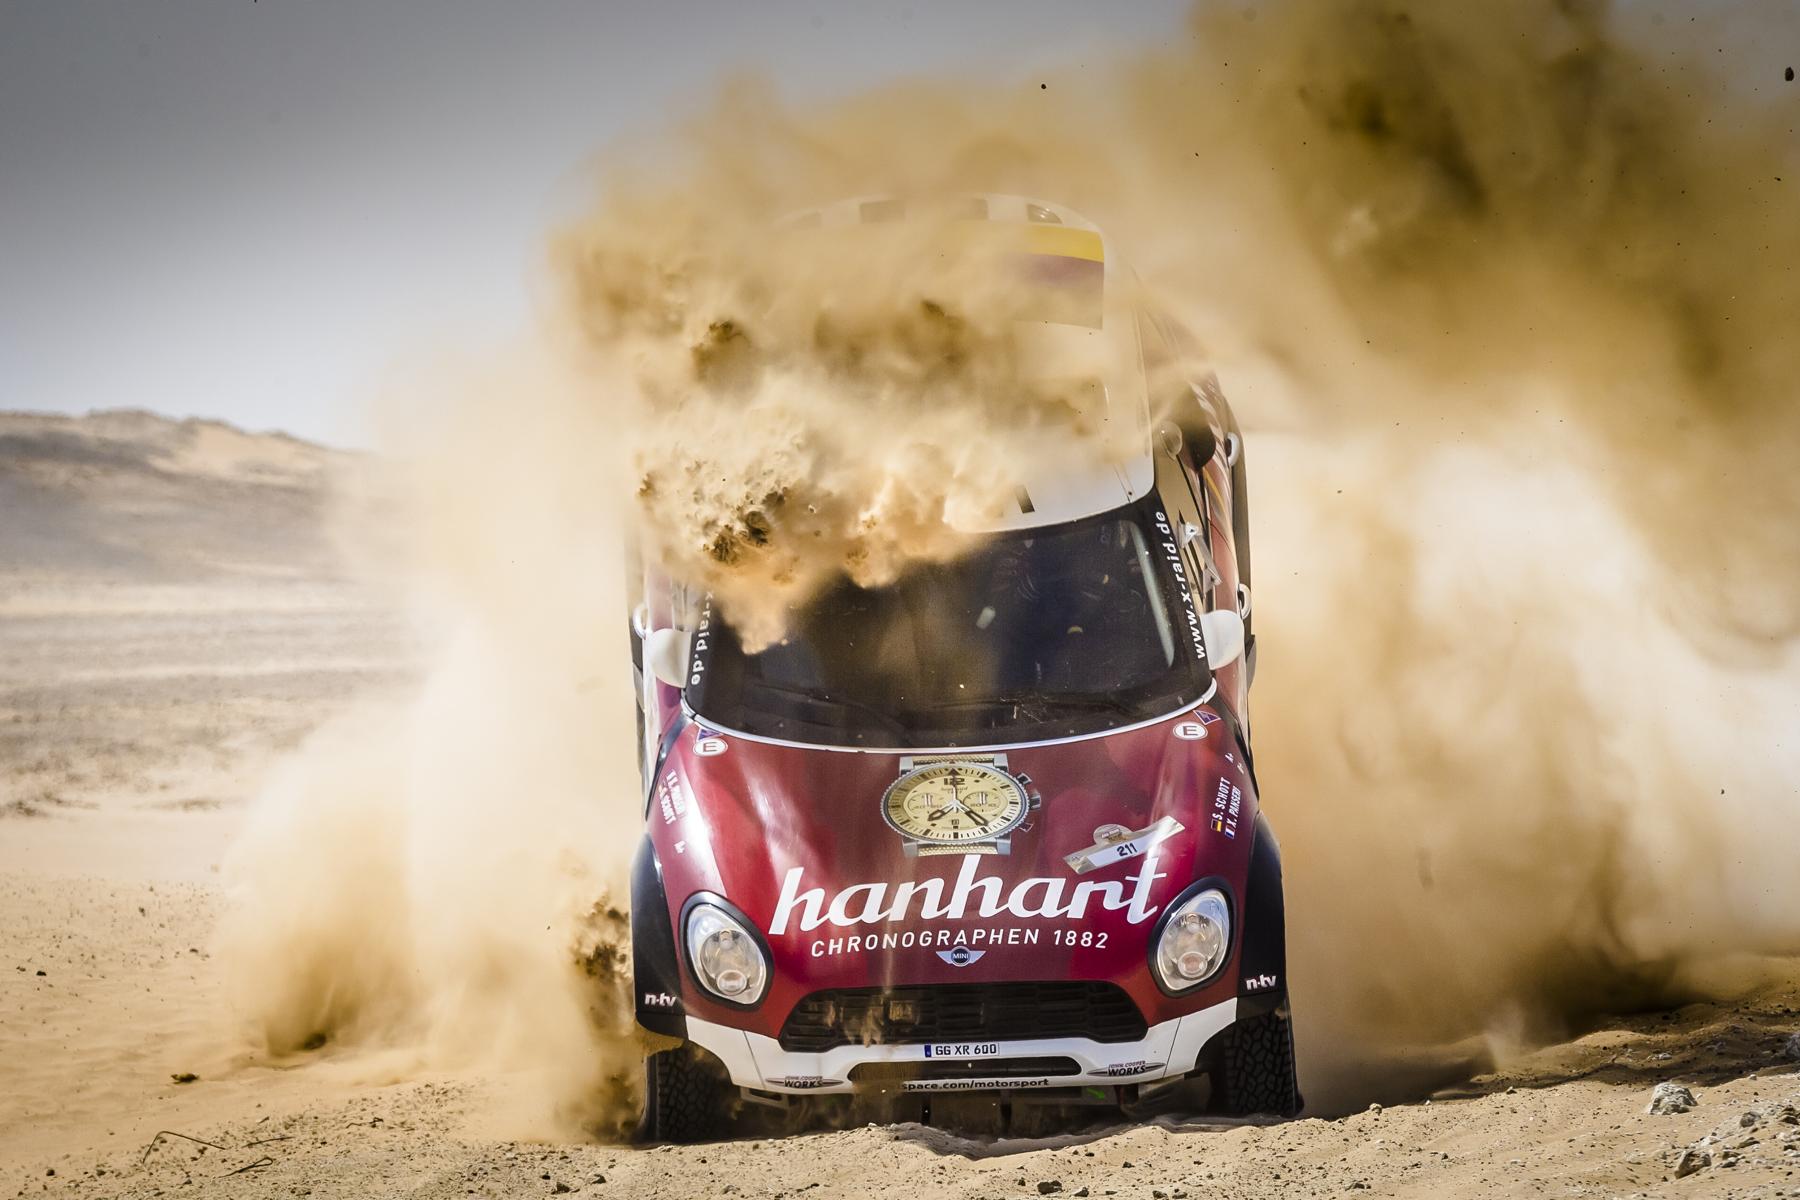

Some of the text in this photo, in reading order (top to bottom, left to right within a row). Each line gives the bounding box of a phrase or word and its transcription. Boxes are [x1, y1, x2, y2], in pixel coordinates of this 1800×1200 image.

[1156, 511, 1206, 659] www.x-raid.de
[1182, 725, 1198, 736] E
[703, 741, 718, 752] E
[1212, 776, 1231, 820] S. SCHOTT
[1226, 818, 1238, 829] X.
[1116, 843, 1138, 857] 211
[768, 855, 1167, 935] hanhart
[811, 929, 1109, 957] CHRONOGRAPHEN 1882
[935, 1044, 997, 1055] GG XR 600
[1108, 1065, 1146, 1076] WORKS
[784, 1080, 823, 1088] WORKS
